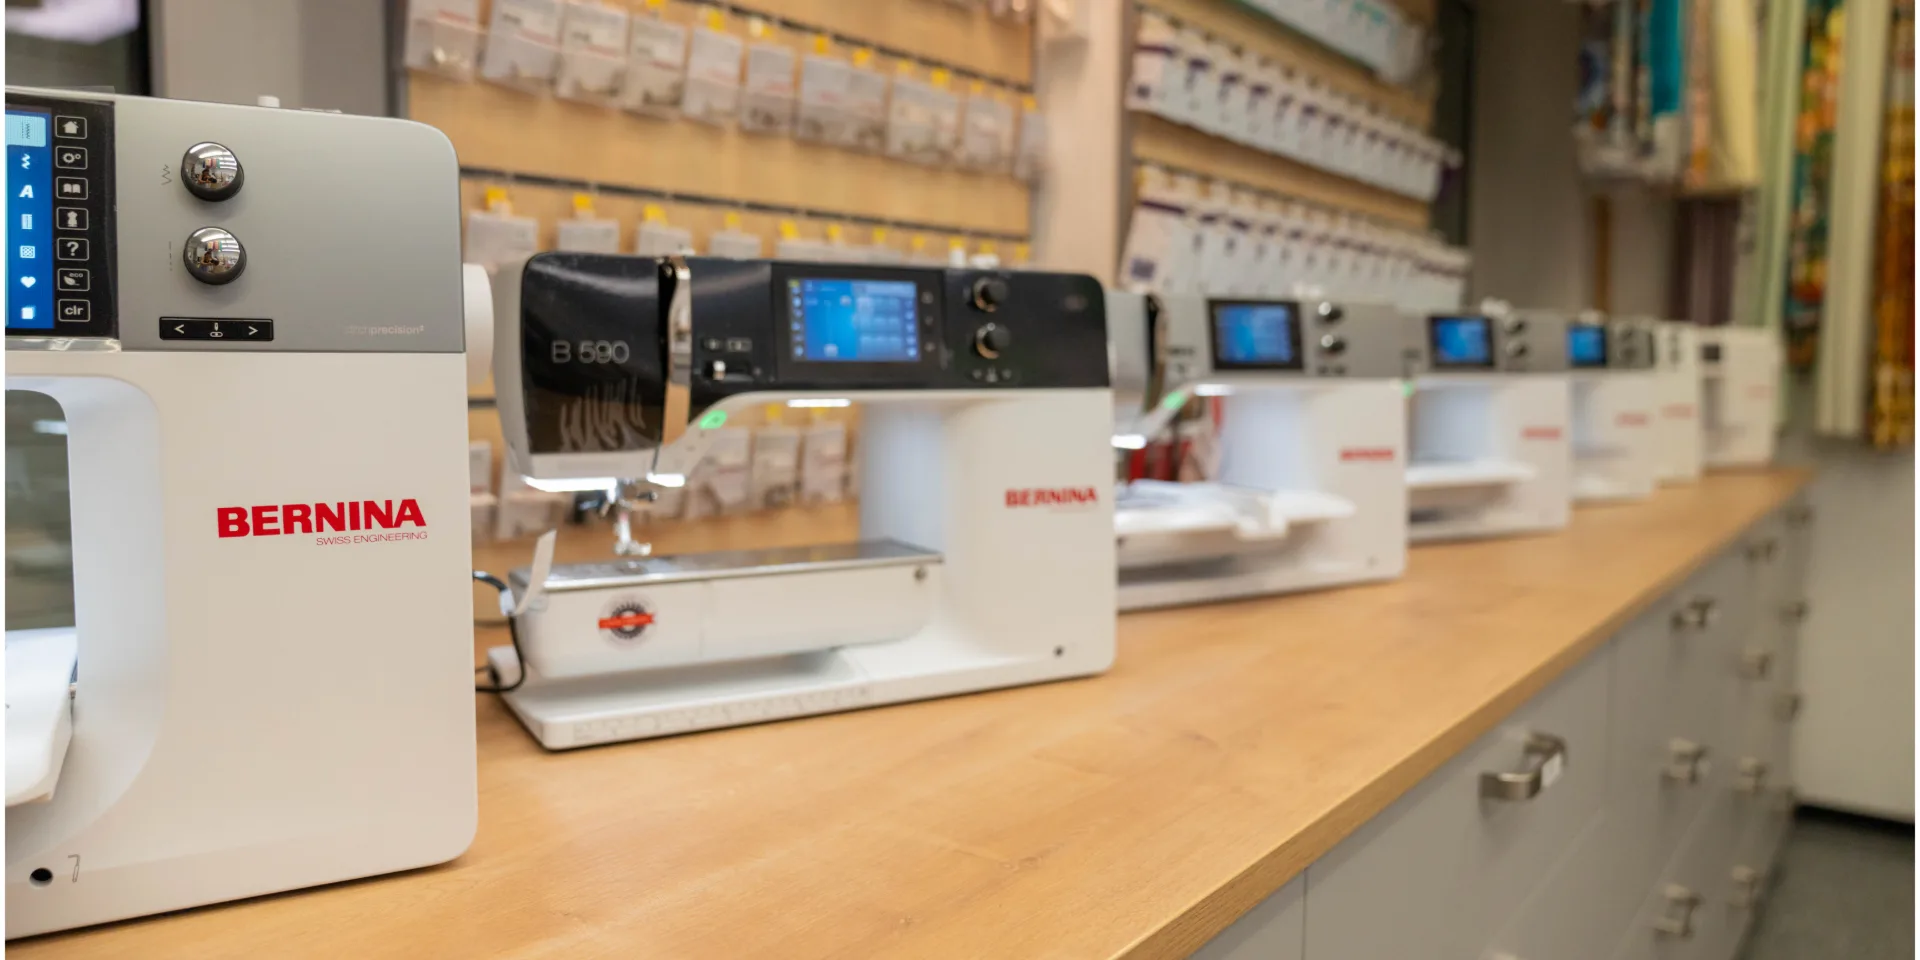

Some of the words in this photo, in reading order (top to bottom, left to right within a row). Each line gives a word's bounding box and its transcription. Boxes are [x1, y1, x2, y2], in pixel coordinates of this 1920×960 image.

[66, 241, 79, 256] ?
[64, 305, 84, 315] clr
[551, 340, 571, 364] B
[579, 340, 630, 364] 590
[1005, 487, 1097, 507] BERNINA
[217, 498, 427, 538] BERNINA
[316, 535, 351, 546] SWISS
[353, 531, 428, 544] ENGINEERING
